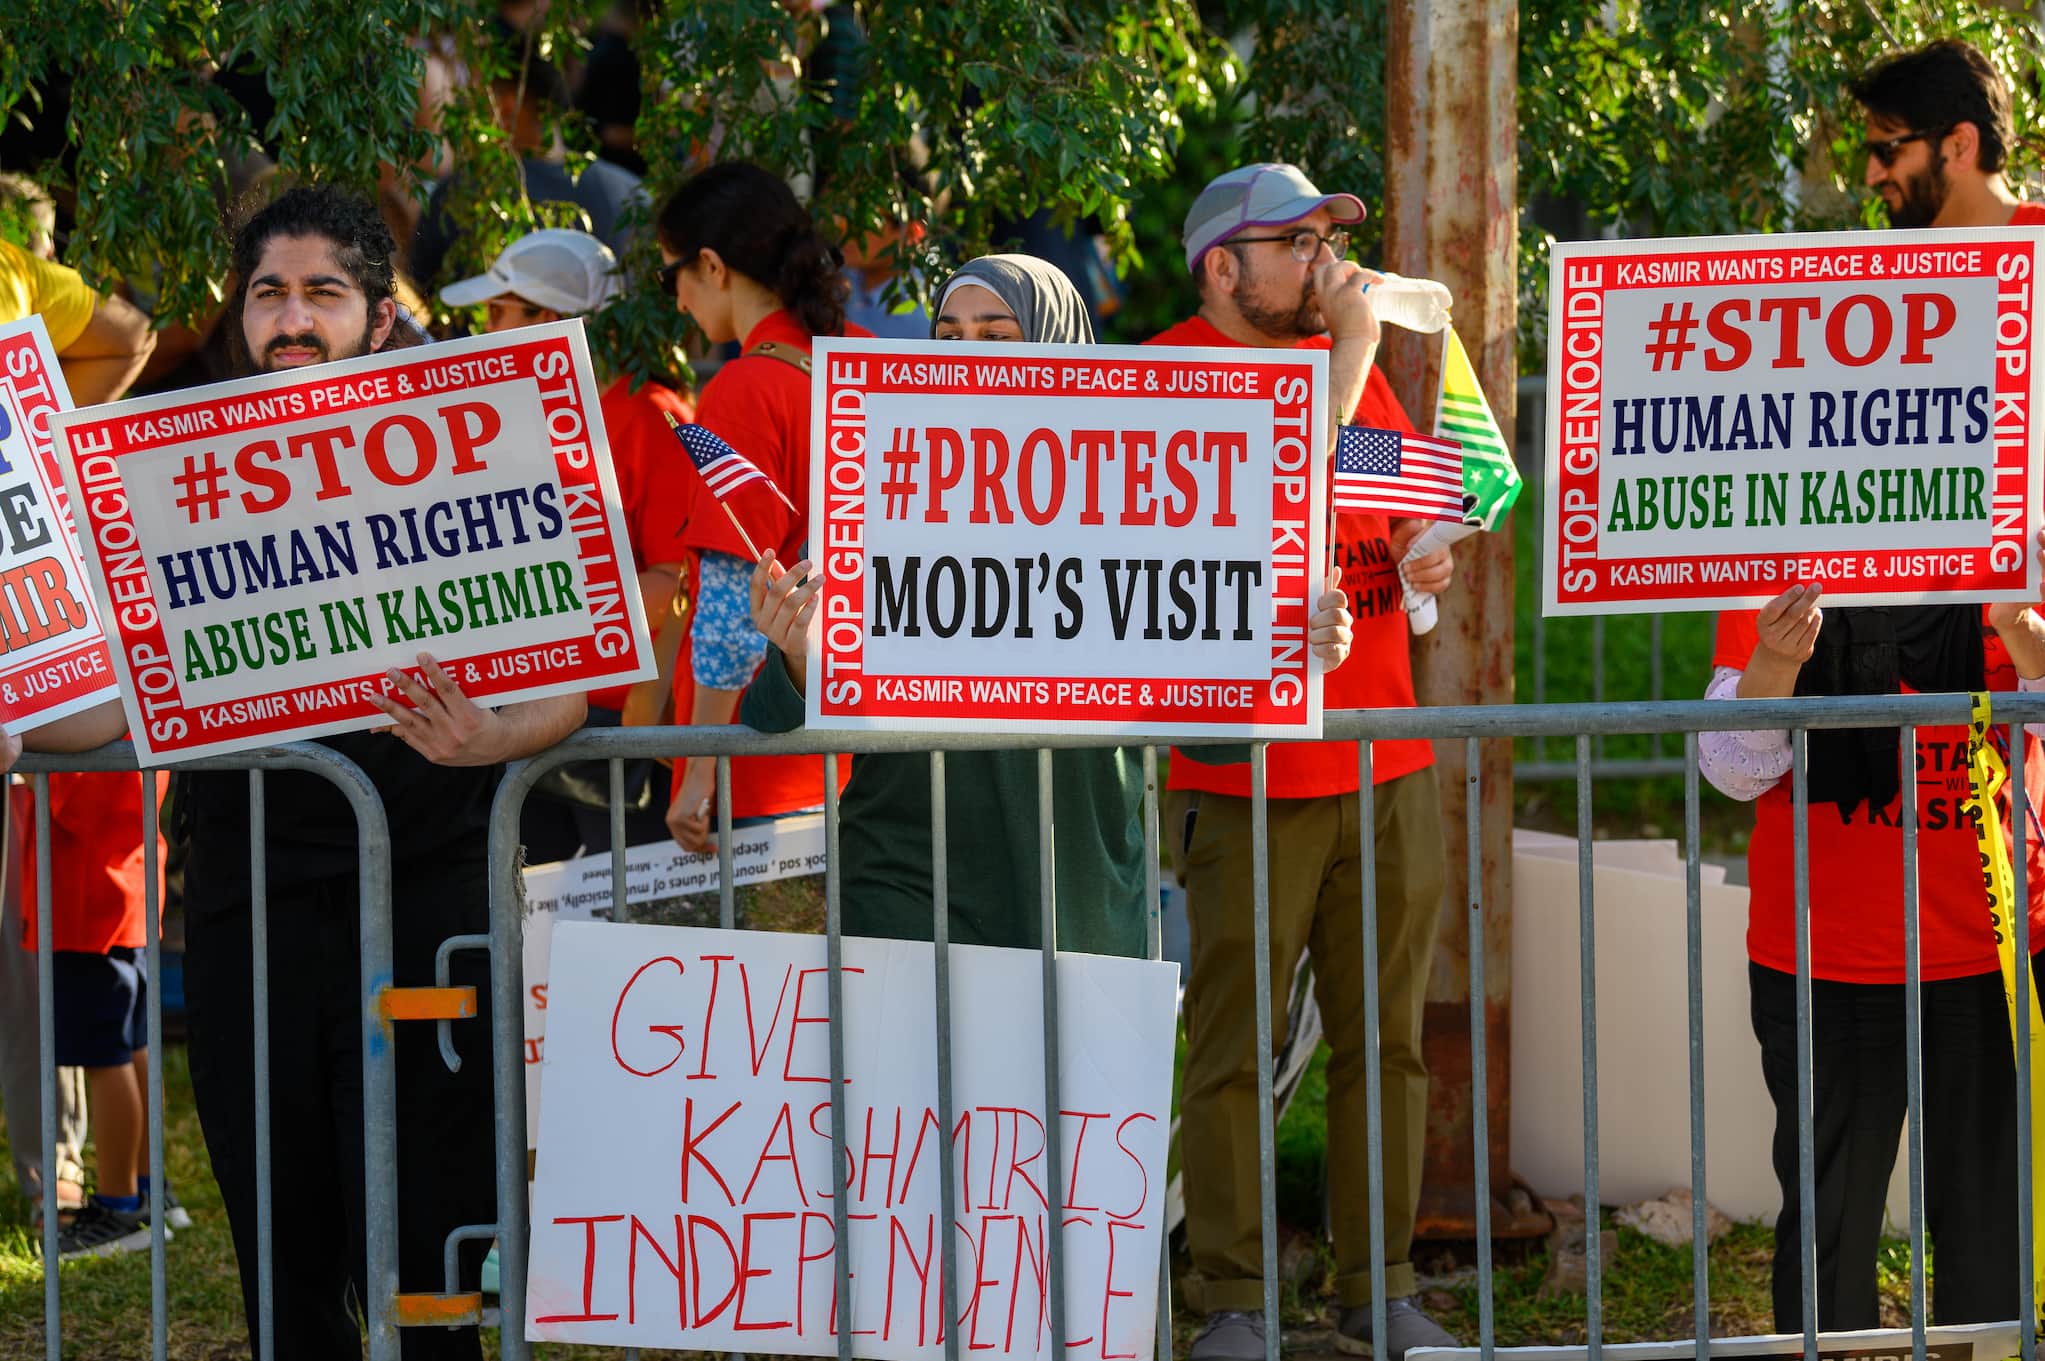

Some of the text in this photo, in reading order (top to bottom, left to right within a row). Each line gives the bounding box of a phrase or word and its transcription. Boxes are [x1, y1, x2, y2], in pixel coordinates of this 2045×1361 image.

[1617, 251, 1981, 285] KASMIR WANTS PEACE & JUSTICE
[881, 362, 1258, 394] KASMIR WANTS PEACE & JUSTICE
[1644, 293, 1957, 372] #STOP
[123, 354, 517, 445] KASMIR WANTS PEACE & JUSTICE
[1563, 263, 1603, 593] STOP GENOCIDE
[1611, 385, 1988, 456] HUMAN RIGHTS
[1989, 252, 2030, 573] STOP KILLING
[172, 402, 501, 524] #STOP
[533, 350, 631, 658] STOP KILLING
[880, 426, 1247, 528] #PROTEST
[1607, 466, 1987, 533] ABUSE IN KASHMIR
[157, 520, 359, 610] HUMAN
[366, 483, 563, 569] RIGHTS
[826, 359, 868, 706] STOP GENOCIDE
[1269, 375, 1309, 709] STOP KILLING
[1325, 537, 1389, 568] TAND
[1609, 554, 1974, 586] KASMIR WANTS PEACE & JUSTICE
[73, 428, 188, 741] STOP GENOCIDE
[184, 560, 583, 683] ABUSE IN KASHMIR
[871, 552, 1084, 639] MODI’S
[1100, 556, 1262, 642] VISIT
[2, 650, 107, 704] & JUSTICE
[199, 695, 291, 730] KASMIR
[291, 680, 376, 713] WANTS
[465, 663, 482, 683] &
[487, 645, 582, 680] JUSTICE
[875, 679, 1253, 709] KASMIR WANTS PEACE & JUSTICE
[612, 955, 864, 1084] GIVE
